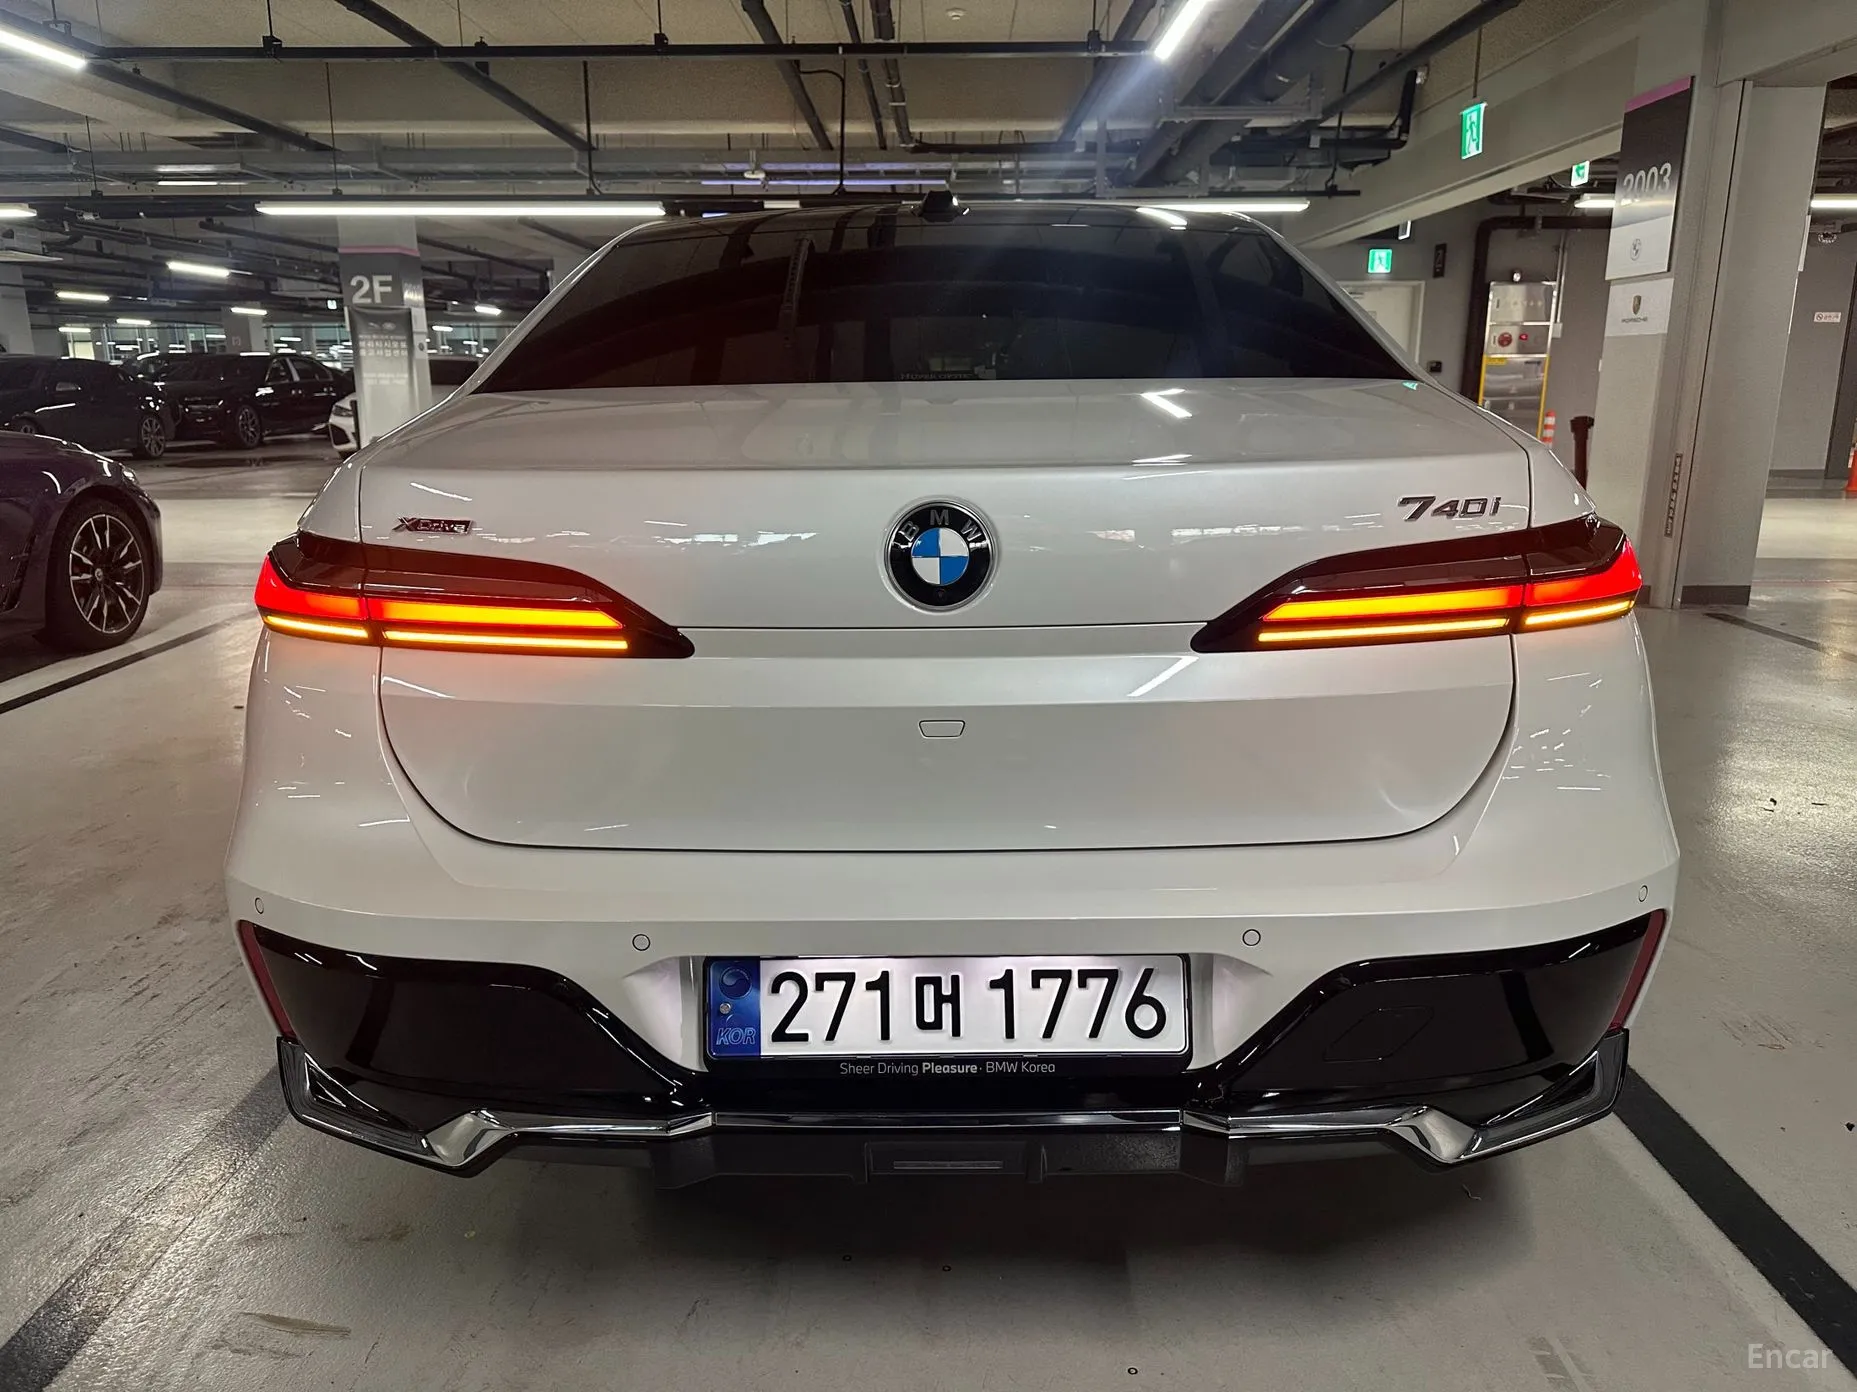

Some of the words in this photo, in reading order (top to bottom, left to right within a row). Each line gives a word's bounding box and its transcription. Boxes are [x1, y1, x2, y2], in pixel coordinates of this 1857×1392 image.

[1620, 162, 1672, 206] 2003
[350, 275, 392, 303] 2F
[1398, 495, 1502, 521] 740i
[899, 509, 982, 541] BMW
[716, 1027, 756, 1045] KOR
[839, 1062, 875, 1075] Sheer
[878, 1062, 919, 1077] Driving
[986, 1061, 1018, 1073] BMW
[1021, 1061, 1056, 1073] Korea
